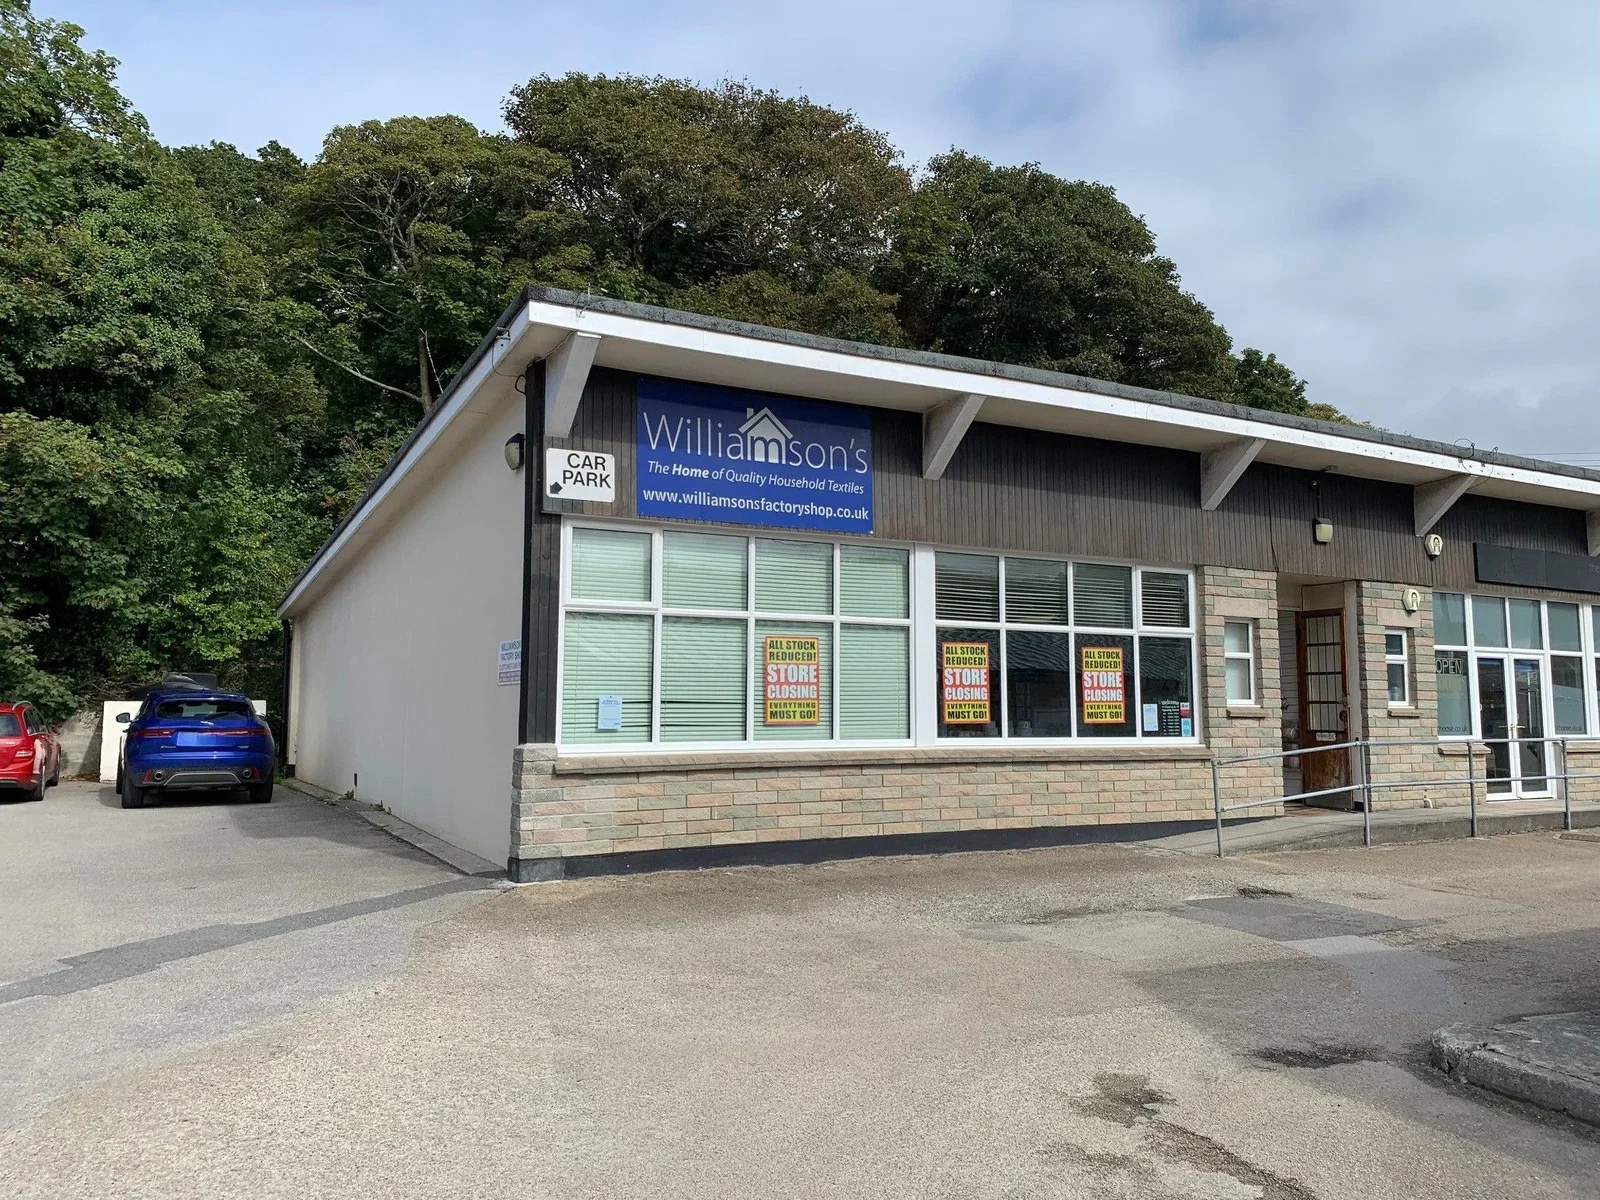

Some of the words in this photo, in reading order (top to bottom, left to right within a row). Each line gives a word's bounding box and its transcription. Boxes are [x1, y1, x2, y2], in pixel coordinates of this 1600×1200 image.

[643, 412, 868, 474] Williamson's
[567, 453, 606, 471] CAR
[562, 469, 611, 489] PARK
[648, 460, 669, 475] The
[672, 463, 709, 479] Home
[711, 468, 725, 480] of
[725, 469, 767, 487] Quality
[769, 473, 826, 491] Household
[828, 479, 864, 494] Textiles
[643, 489, 869, 520] www.williamsonsfactoryshop.co.uk
[769, 640, 784, 650] ALL
[786, 640, 816, 651] STOCK
[945, 646, 959, 655] ALL
[960, 646, 986, 656] STOCK
[769, 651, 816, 661] REDUCED!
[945, 656, 987, 666] REDUCED!
[1084, 651, 1097, 659] ALL
[1097, 650, 1120, 660] STOCK
[1084, 660, 1121, 669] REDUCED!
[1435, 659, 1462, 674] OPEN
[767, 664, 817, 683] STORE
[944, 668, 987, 686] STORE
[1083, 671, 1122, 688] STORE
[767, 684, 817, 699] CLOSING
[945, 687, 988, 701] CLOSING
[1084, 688, 1122, 702] CLOSING
[769, 701, 816, 709] EVERYTHING
[769, 710, 797, 719] MUST
[799, 710, 816, 719] GO!
[947, 710, 971, 720] MUST
[973, 710, 988, 720] GO!
[1087, 711, 1108, 719] MUST
[1109, 711, 1122, 720] GO!
